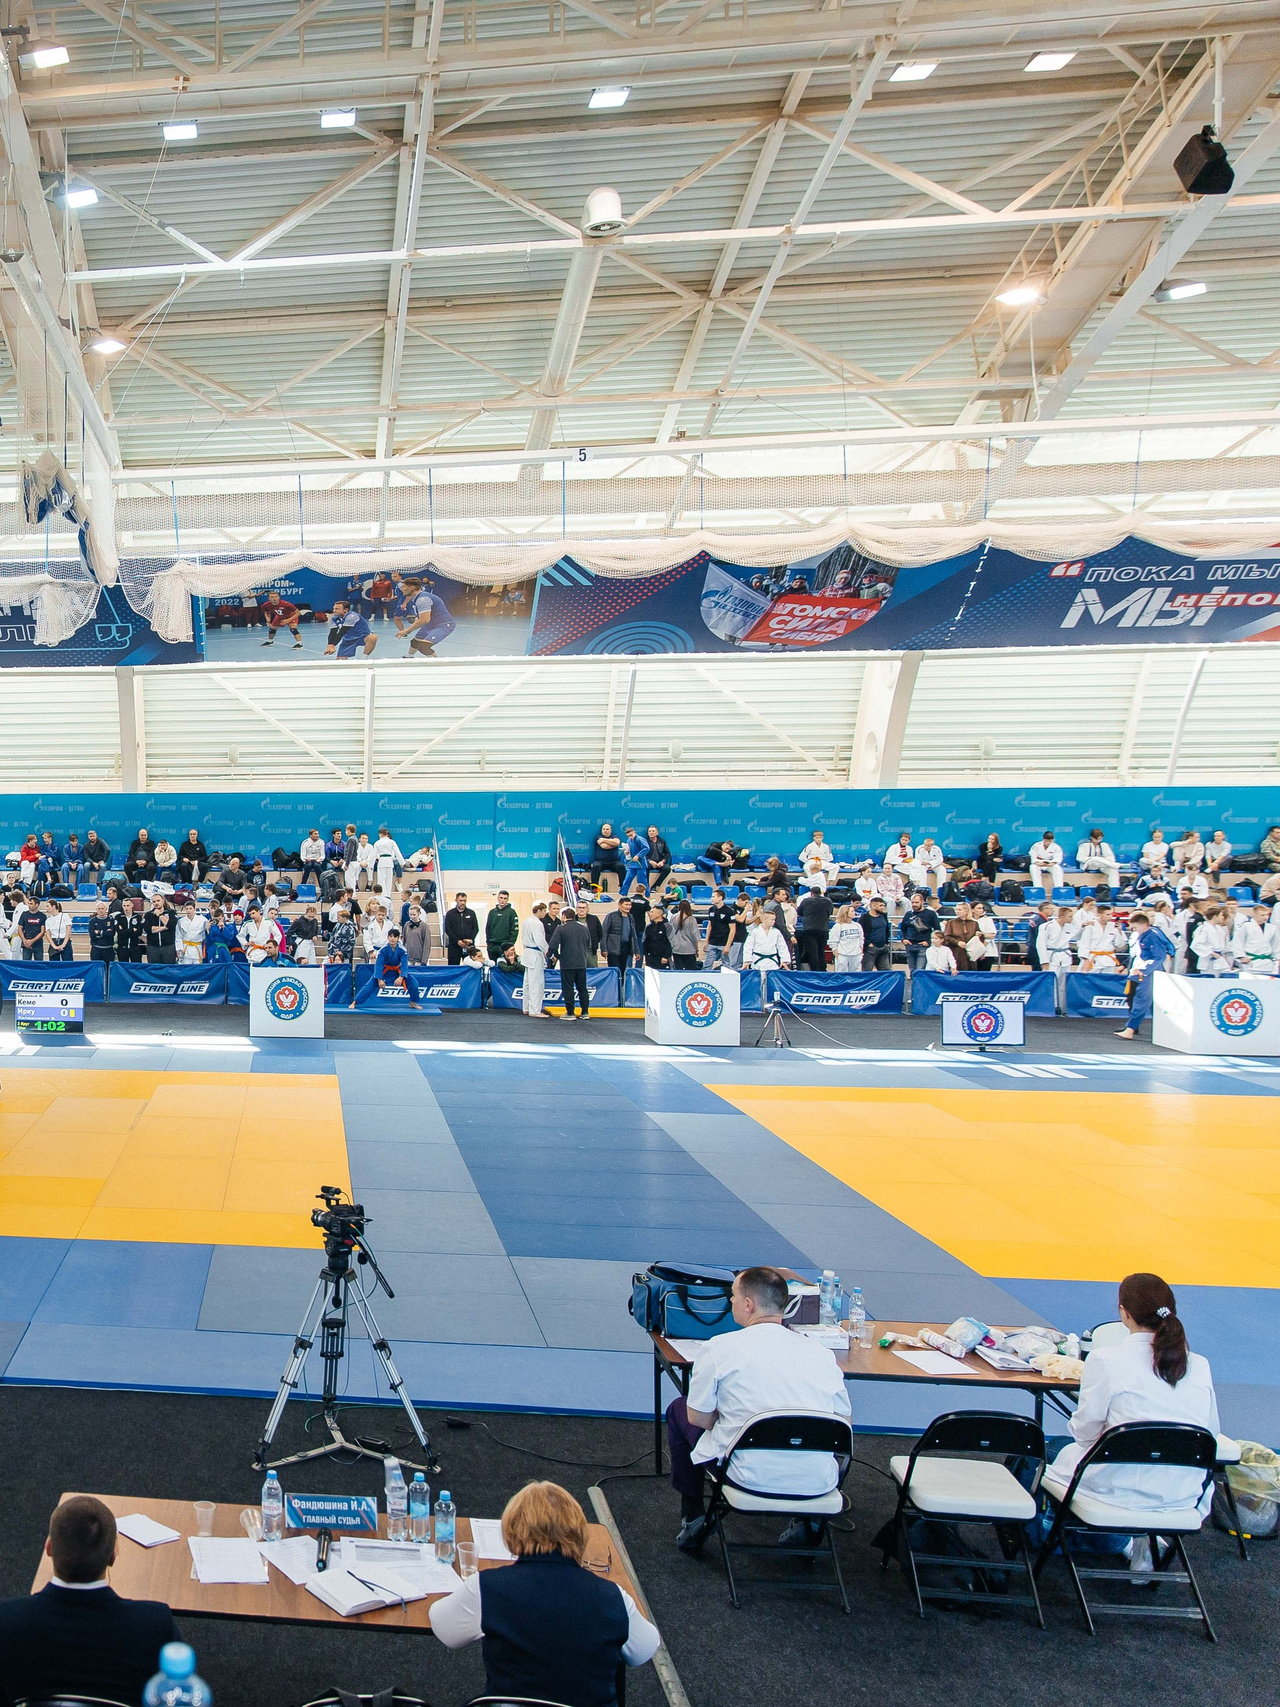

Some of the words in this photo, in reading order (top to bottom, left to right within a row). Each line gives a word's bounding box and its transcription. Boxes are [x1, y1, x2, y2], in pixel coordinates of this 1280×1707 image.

[578, 448, 588, 462] 5
[1084, 565, 1195, 582] ПОКА
[214, 598, 240, 606] 2022
[1060, 586, 1230, 628] МЫ
[769, 617, 847, 634] СИЛА
[12, 982, 52, 990] START
[56, 982, 82, 990] LINE
[134, 984, 175, 993] START
[179, 985, 207, 993] LINE
[429, 988, 457, 997] LINE
[60, 998, 68, 1006] 0
[676, 985, 692, 1017] ФЕДЕРАЦИЯ
[694, 983, 716, 994] ДЗЮДО
[715, 993, 723, 1017] РОССИИ
[793, 995, 841, 1004] START
[847, 995, 877, 1004] LINE
[17, 1008, 36, 1016] Ирку
[60, 1008, 68, 1017] 0
[1211, 991, 1230, 1026] ФЕДЕРАЦИЯ
[1231, 989, 1256, 1000] ДЗЮДО
[1254, 1001, 1263, 1027] РОССИИ
[34, 1021, 66, 1031] 1:02
[292, 1498, 348, 1511] Фандюшина
[302, 1514, 337, 1524] ГЛАВНЫЙ
[337, 1516, 361, 1525] СУДЬЯ
